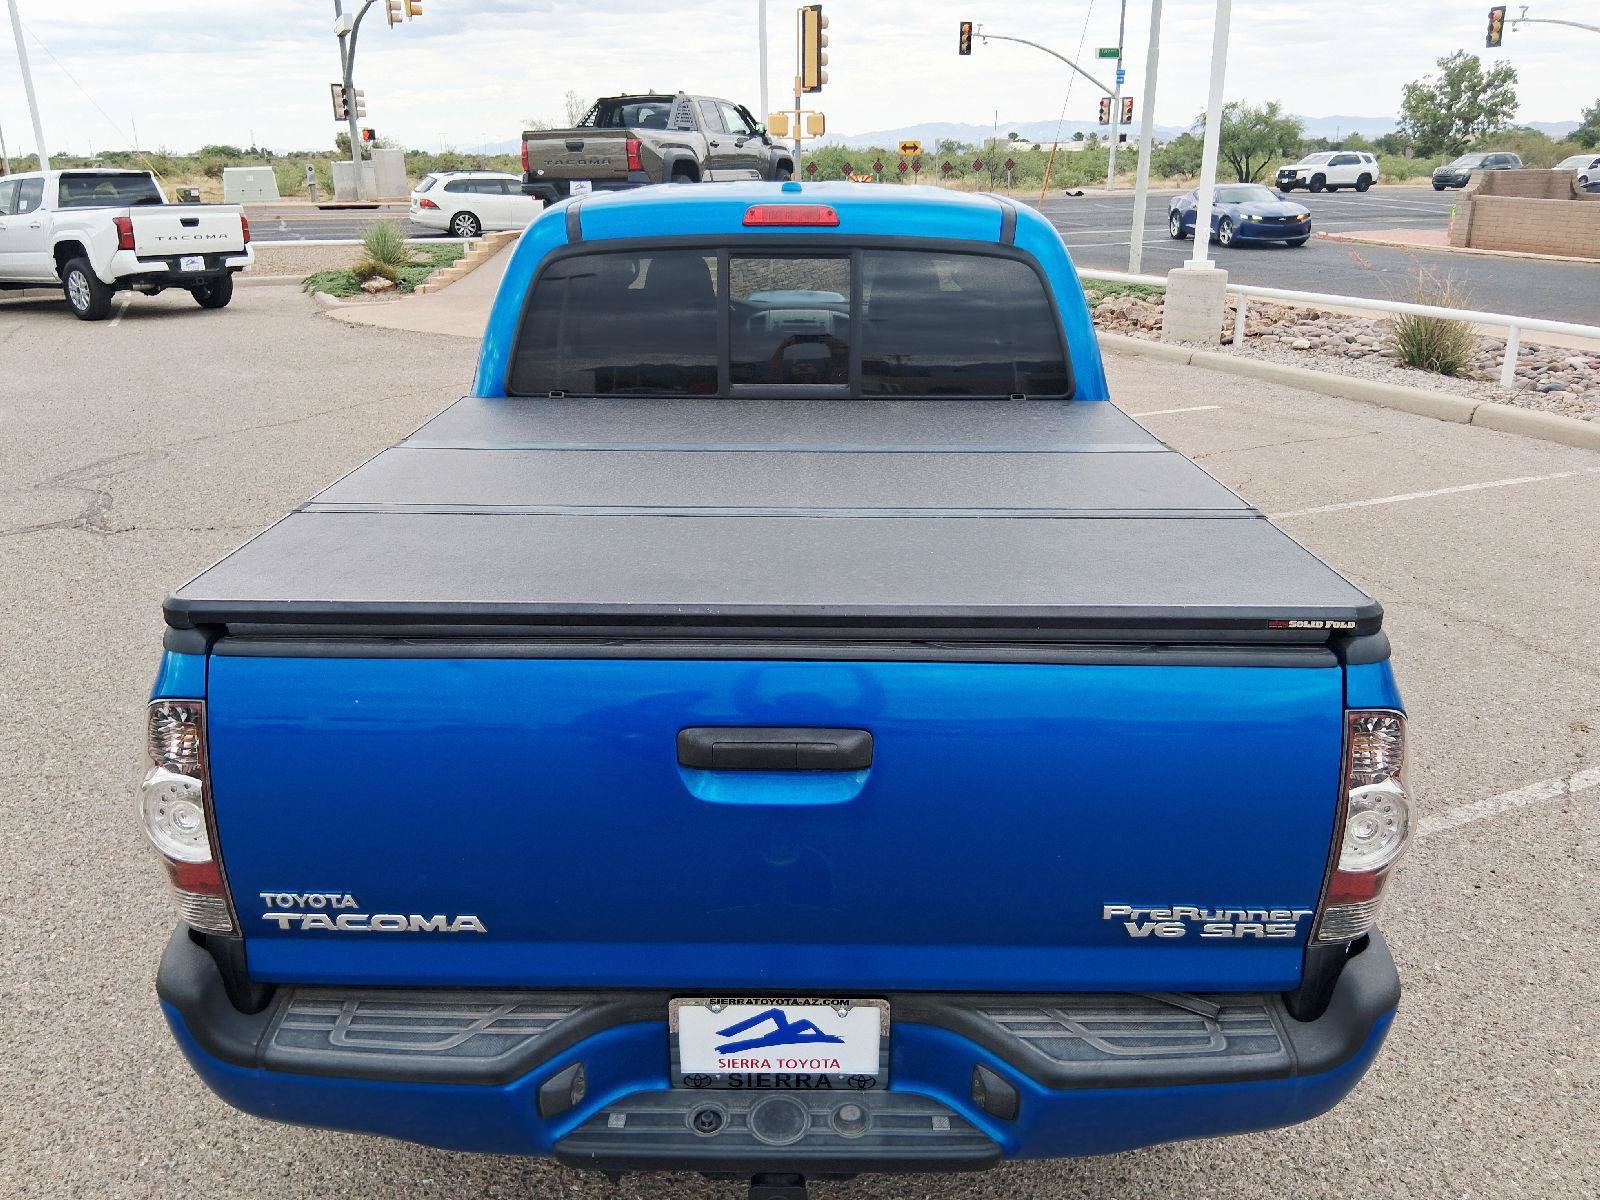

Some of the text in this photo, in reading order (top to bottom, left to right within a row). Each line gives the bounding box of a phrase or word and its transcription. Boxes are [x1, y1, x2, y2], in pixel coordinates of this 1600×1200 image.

[154, 233, 229, 241] TACOMA
[1288, 620, 1323, 628] SOLID
[1325, 620, 1356, 629] FOLD
[259, 892, 359, 909] TOYOTA
[1103, 904, 1314, 921] PreRunner
[262, 912, 488, 933] TACOMA
[1123, 922, 1187, 938] V6
[709, 998, 850, 1006] SIERRATOYOTA-AZ.COM
[718, 1058, 841, 1069] SIERRA TOYOTA
[727, 1073, 832, 1089] SIERRA
